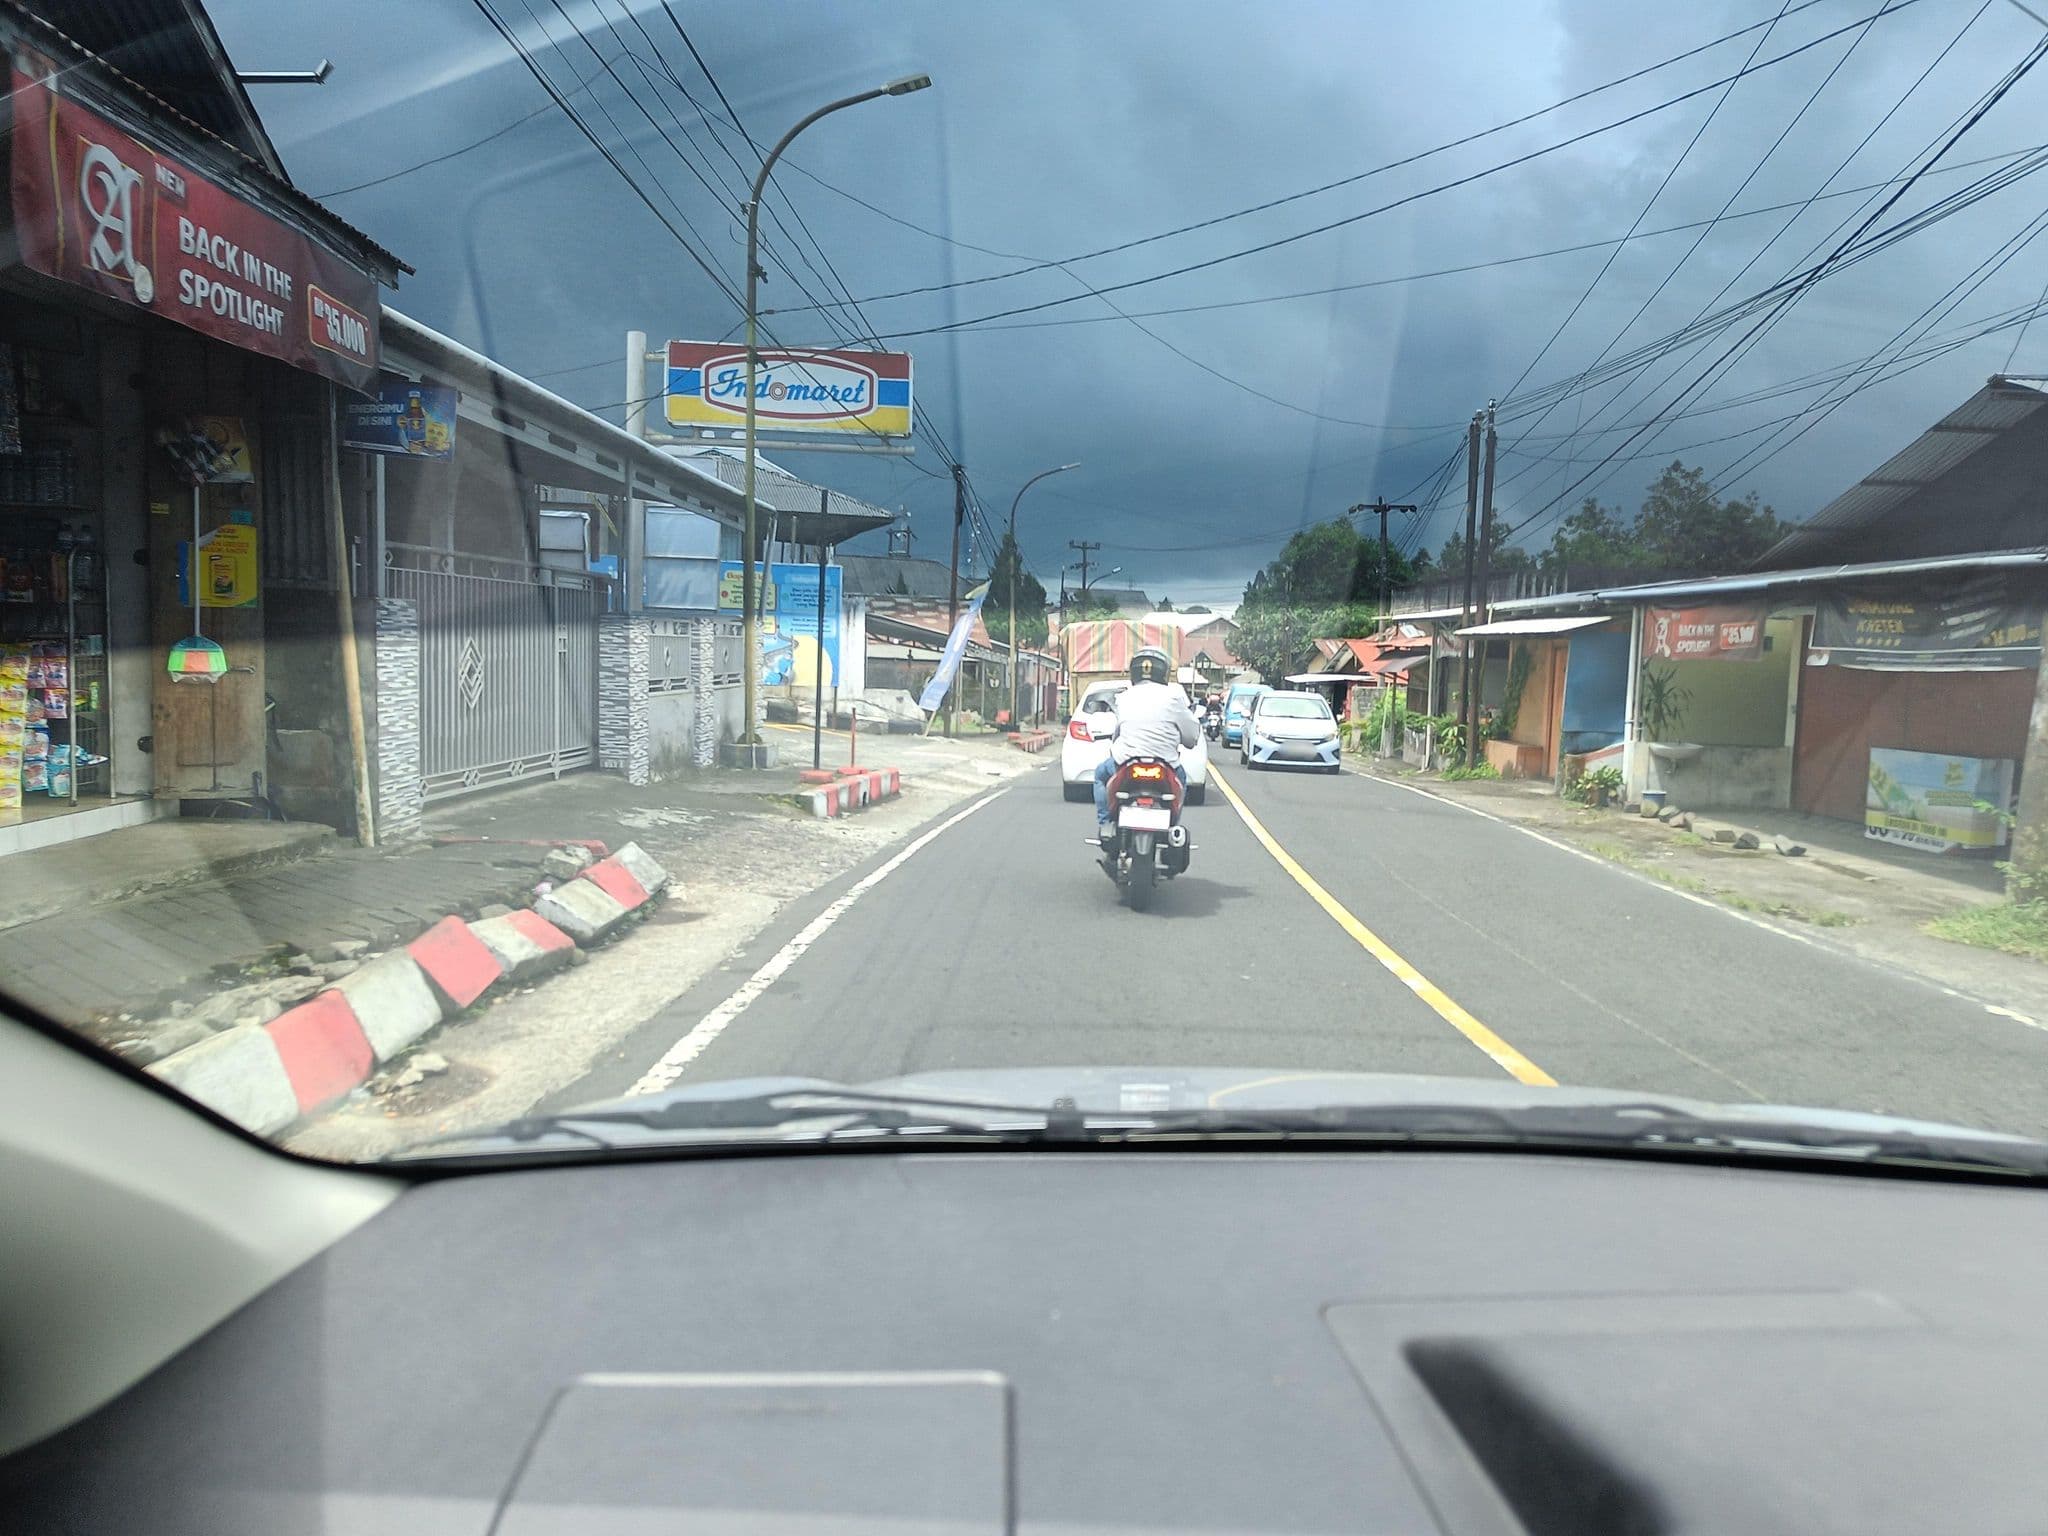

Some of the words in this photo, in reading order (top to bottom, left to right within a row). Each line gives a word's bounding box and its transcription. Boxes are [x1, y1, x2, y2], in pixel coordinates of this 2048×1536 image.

[178, 215, 241, 277] BACK
[242, 251, 262, 287] IN
[263, 261, 293, 301] THE
[178, 267, 285, 337] SPOTLIGHT
[710, 368, 866, 404] Indomaret
